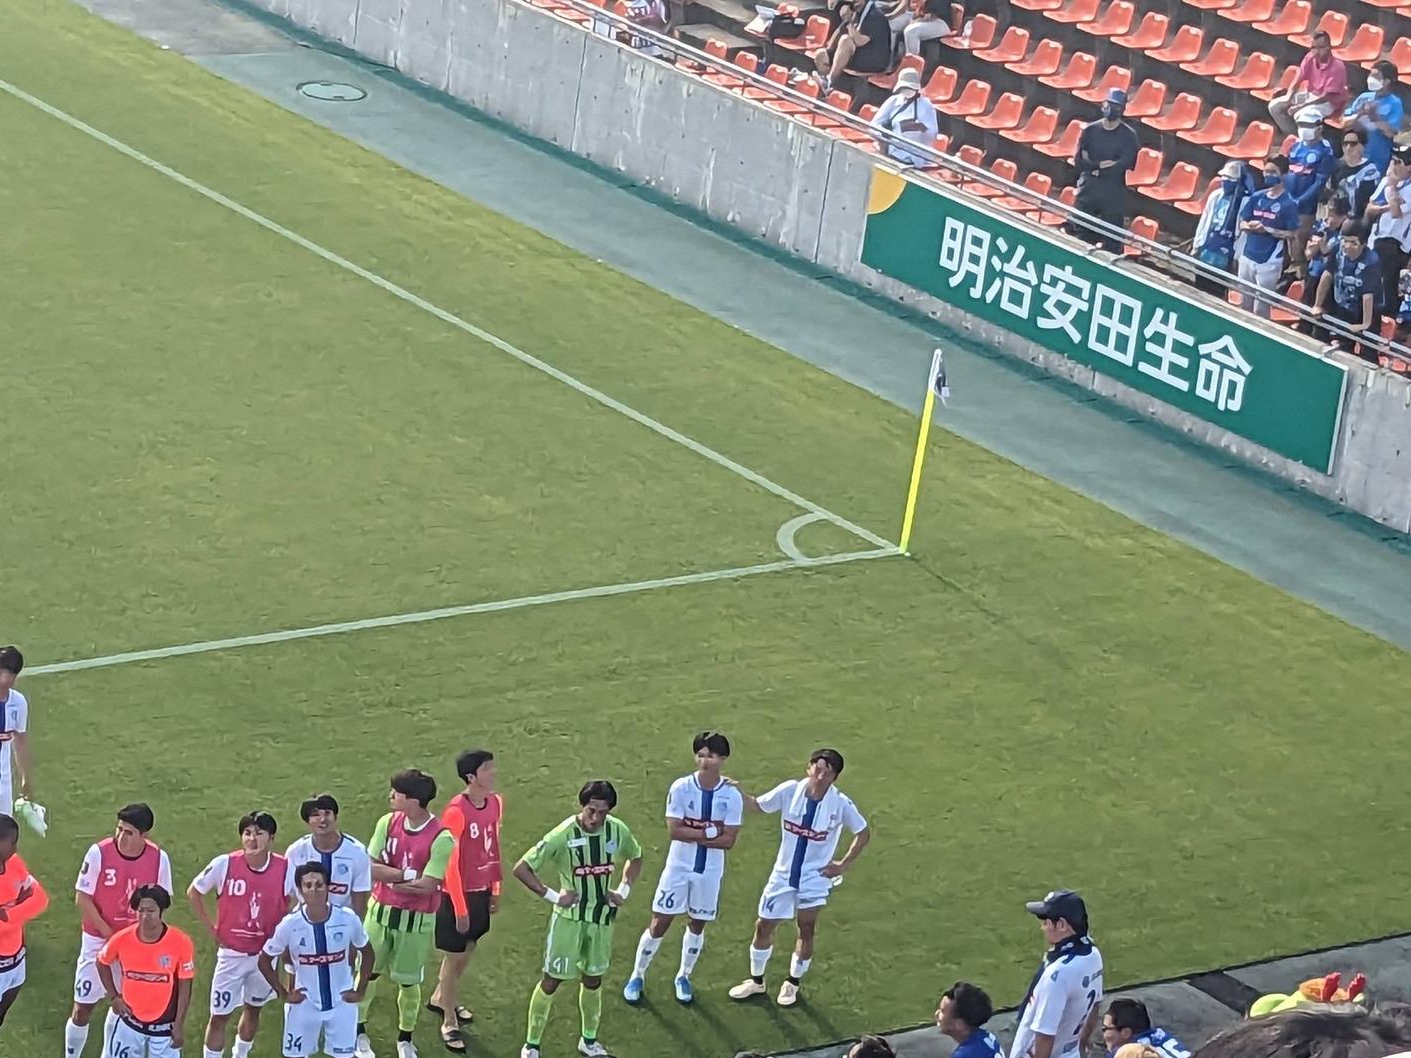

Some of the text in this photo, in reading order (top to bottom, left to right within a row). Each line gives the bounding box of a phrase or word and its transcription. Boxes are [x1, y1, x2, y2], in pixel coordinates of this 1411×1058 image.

[939, 215, 1253, 413] 明治安田生命
[469, 822, 480, 839] 8
[104, 868, 117, 886] 3
[227, 879, 246, 896] 10
[657, 889, 675, 909] 26
[213, 990, 231, 1009] 39
[284, 1032, 302, 1053] 34
